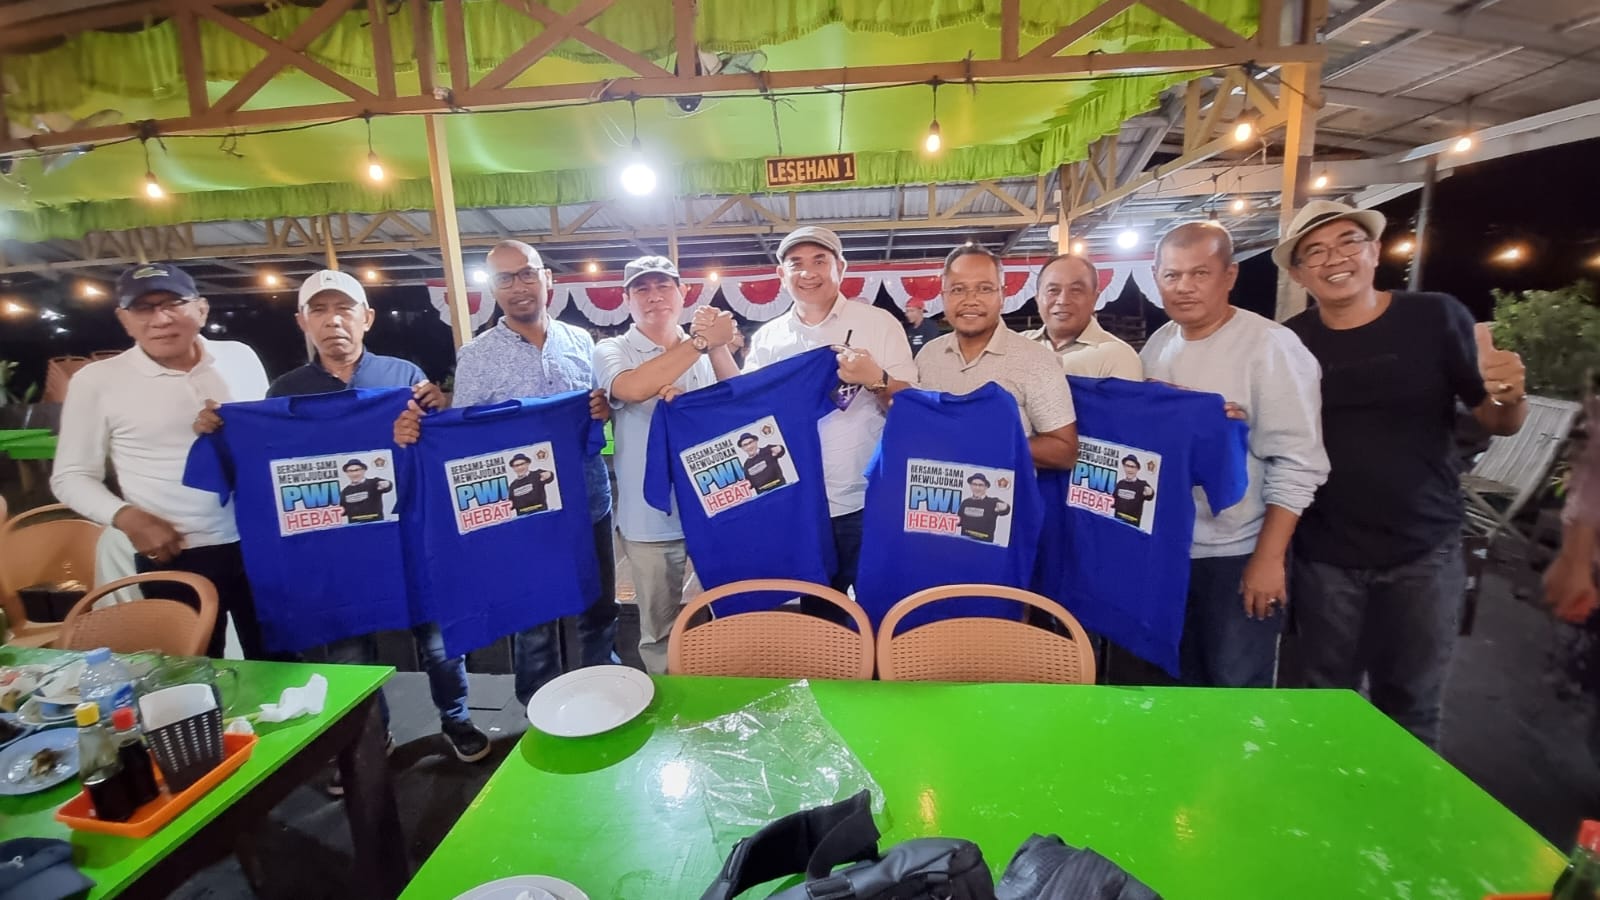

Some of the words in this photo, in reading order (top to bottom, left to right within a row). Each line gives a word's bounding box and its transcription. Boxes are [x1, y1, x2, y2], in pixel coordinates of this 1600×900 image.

[769, 159, 840, 183] LESEHAN
[844, 158, 853, 177] 1
[685, 439, 734, 464] BERSAMA-SAMA
[689, 447, 737, 472] MEWUJUDKAN
[1080, 442, 1119, 459] ERSAMA-SAMA
[277, 461, 338, 475] BERSAMA-SAMA
[279, 470, 339, 484] MEWUJUDKAN
[451, 457, 505, 475] BERSAMA-SAMA
[453, 465, 507, 484] MEWUJUDKAN
[694, 457, 747, 496] PWI
[910, 465, 964, 478] BERSAMA-SAMA
[1072, 461, 1117, 495] PWI
[456, 476, 510, 511] PWI
[910, 474, 963, 488] MEWUJUDKAN
[280, 481, 341, 512] PWI
[707, 483, 751, 511] HEBAT
[908, 485, 962, 514] PWI
[1071, 487, 1113, 513] HEBAT
[287, 509, 343, 530] HEBAT
[463, 503, 512, 528] HEBAT
[909, 513, 959, 531] HEBAT
